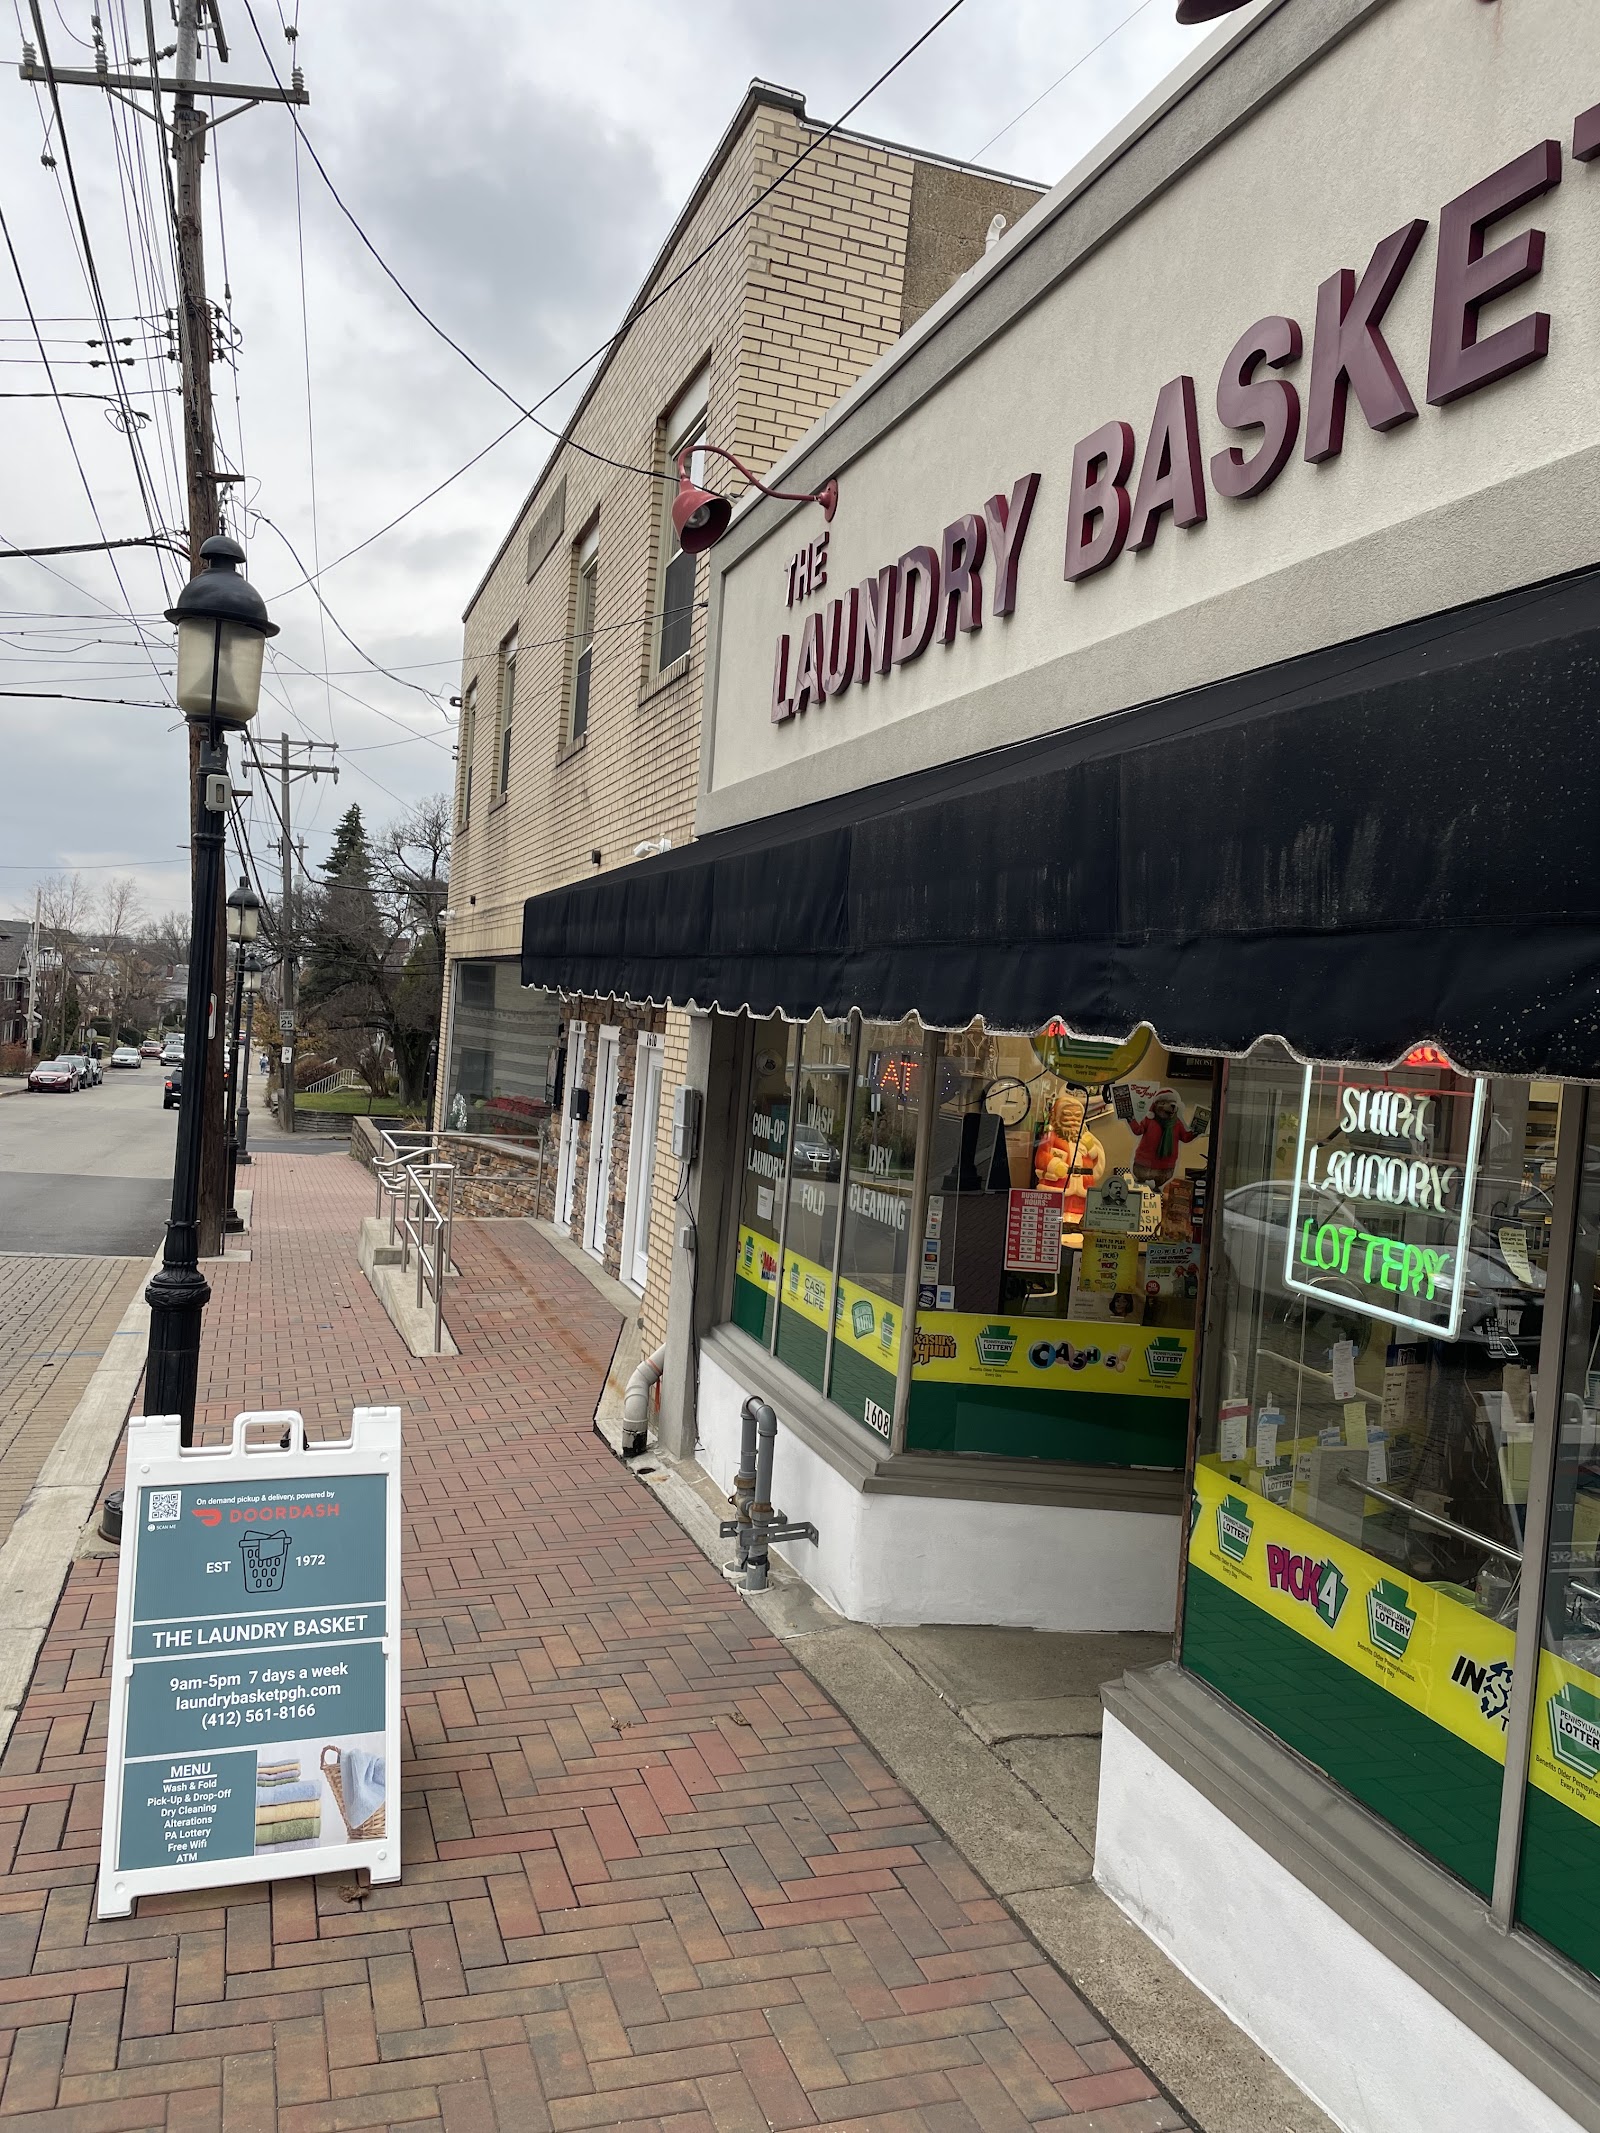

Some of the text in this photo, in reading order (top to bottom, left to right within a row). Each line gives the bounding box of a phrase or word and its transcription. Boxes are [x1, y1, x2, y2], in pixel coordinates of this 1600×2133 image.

[784, 531, 829, 608] THE
[771, 472, 1041, 724] LAUNDRY
[281, 1020, 293, 1028] 25
[807, 1102, 835, 1135] WASH
[1340, 1086, 1431, 1142] SHIRT
[747, 1147, 785, 1182] LAUNDRY
[868, 1143, 893, 1177] DRY
[1308, 1144, 1457, 1213] LAUNDRY
[802, 1183, 825, 1217] FOLD
[849, 1183, 906, 1231] CLEANING
[1021, 1192, 1052, 1200] BUSINESS
[1142, 1201, 1157, 1209] LM
[1301, 1217, 1453, 1300] LOTTERY
[804, 1277, 826, 1299] CASH
[803, 1292, 825, 1312] 4LIFE
[913, 1342, 957, 1365] Hunt
[983, 1343, 1013, 1351] LOTTERY
[1031, 1342, 1099, 1368] CASH
[1153, 1355, 1183, 1363] LOTTERY
[866, 1400, 889, 1436] 1608
[208, 1496, 236, 1505] demand
[236, 1495, 260, 1505] pickup
[261, 1494, 267, 1502] &
[268, 1492, 295, 1502] delivery,
[296, 1491, 325, 1501] powered
[326, 1491, 335, 1499] by
[229, 1503, 340, 1523] DOORDASH
[1223, 1514, 1250, 1533] PENNSYLVANIA
[1222, 1520, 1249, 1543] LOTTERY
[206, 1555, 326, 1574] EST 1972
[1222, 1565, 1231, 1575] Every
[1375, 1601, 1411, 1627] PENNSYLVANIA
[1375, 1608, 1410, 1637] LOTTERY
[152, 1615, 368, 1649] THE LAUNDRY BASKET
[1357, 1641, 1416, 1682] Benefits Older Pennsylvanians.
[1375, 1660, 1396, 1679] Every Day.
[170, 1661, 349, 1692] 9am-5pm 7 days a week
[175, 1683, 341, 1711] laundrybasketpgh.com
[201, 1703, 316, 1730] (412) 561-8166
[1501, 1714, 1510, 1732] T
[1560, 1709, 1600, 1738] PENNSYLVAN
[1559, 1718, 1600, 1751] LOTTER
[170, 1762, 211, 1778] MENU
[1536, 1754, 1557, 1773] Benefits
[1557, 1765, 1572, 1779] Older
[163, 1779, 217, 1793] Wash & Fold
[1560, 1780, 1587, 1801] Every Day.
[147, 1789, 232, 1807] Pick-Up & Drop-Off
[161, 1804, 217, 1818] Dry Cleaning
[164, 1816, 213, 1829] Alterations
[164, 1828, 211, 1840] PA Lottery
[168, 1839, 207, 1852] Free Wifi
[176, 1852, 198, 1863] ATM
